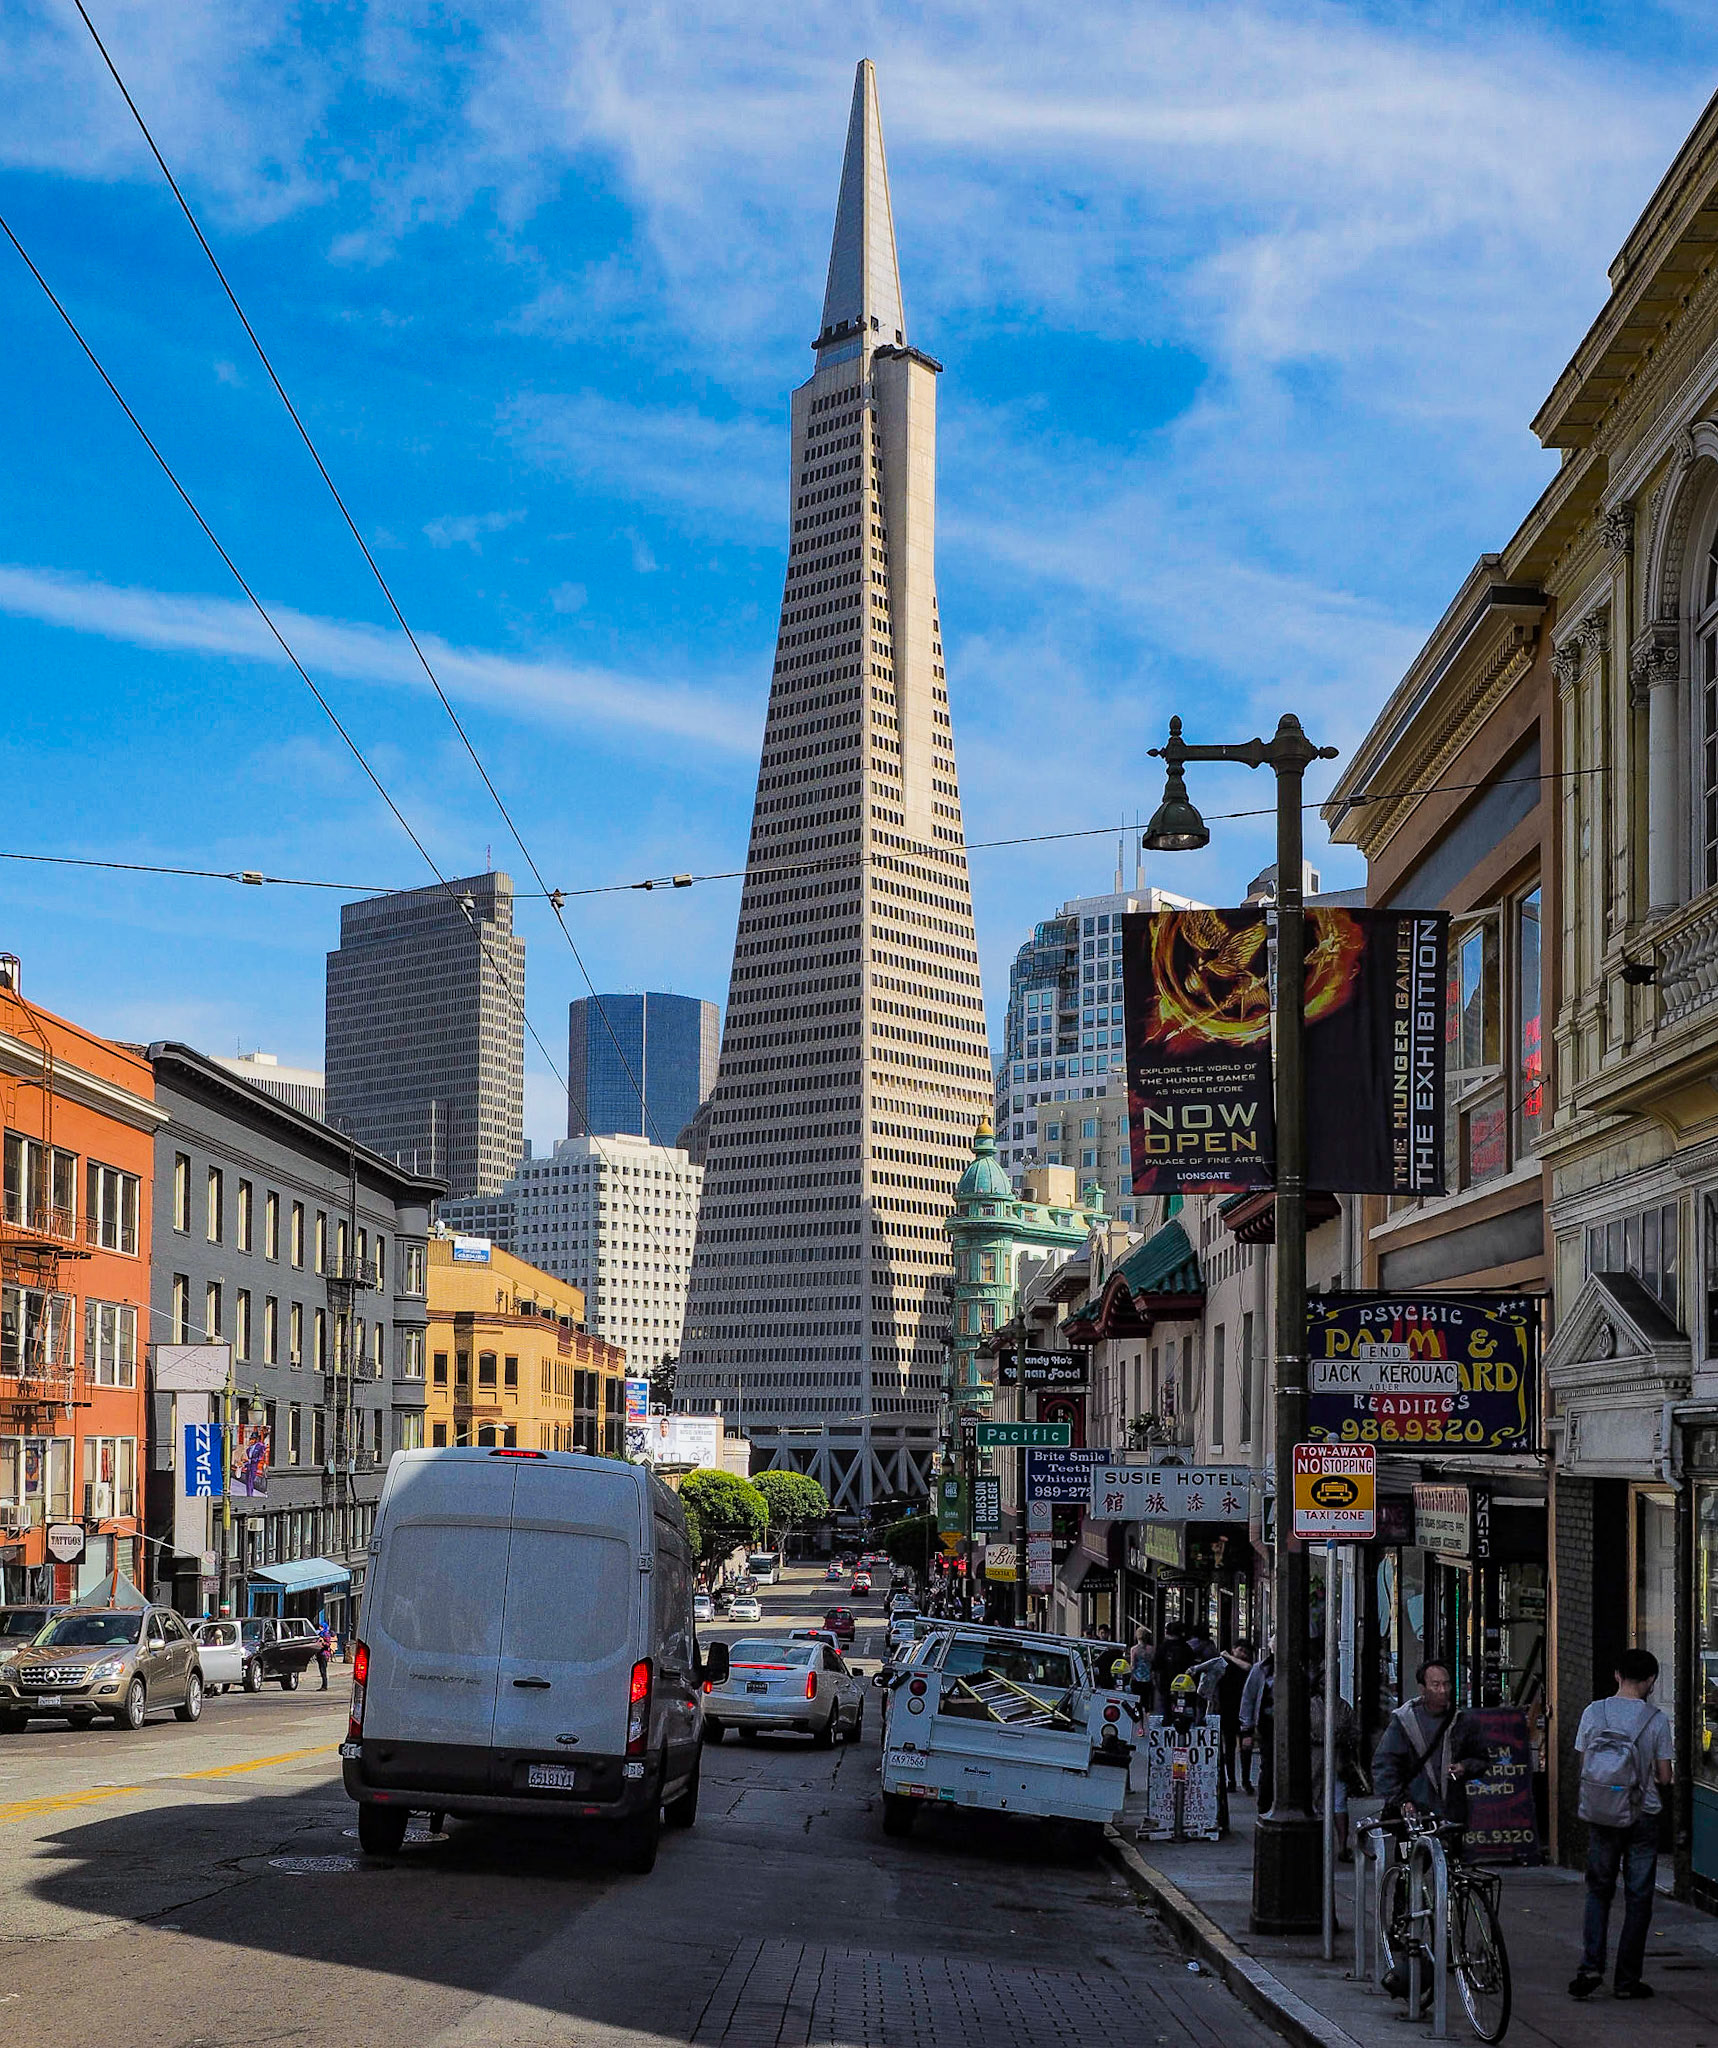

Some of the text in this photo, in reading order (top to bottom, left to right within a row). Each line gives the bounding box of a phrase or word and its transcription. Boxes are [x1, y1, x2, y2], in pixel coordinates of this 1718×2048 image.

[1393, 920, 1411, 1189] THE HUNGER GAMES
[1416, 919, 1438, 1190] THE EXHIBITION
[1140, 1066, 1182, 1075] EXPLORE
[1206, 1064, 1241, 1072] WORLD
[1140, 1073, 1256, 1085] THE HUNGER GAMES
[1172, 1087, 1203, 1095] NEVER
[1206, 1085, 1244, 1093] BEFORE
[1143, 1101, 1258, 1130] NOW
[1144, 1130, 1257, 1154] OPEN
[1144, 1155, 1262, 1166] PALACE OF FINE ARTS
[1177, 1171, 1231, 1180] LIONSGATE
[1360, 1305, 1464, 1325] PSYCHIC
[1468, 1329, 1498, 1358] &
[1369, 1346, 1401, 1357] END
[1004, 1367, 1080, 1380] Hnan Food
[1319, 1365, 1456, 1383] JACK KEROUAC
[1458, 1362, 1518, 1391] ARD
[1369, 1383, 1399, 1391] ADLER
[1353, 1394, 1470, 1414] READINGS
[987, 1428, 1059, 1441] Pacific
[1340, 1419, 1484, 1442] 986.9320
[1034, 1451, 1105, 1462] Brite Smile
[1300, 1446, 1368, 1457] TOW-AWAY
[196, 1424, 211, 1496] SFJAZZ
[1297, 1458, 1372, 1474] NO STOPPING
[1047, 1464, 1090, 1473] Teeth
[1031, 1474, 1090, 1483] Whiteni
[1104, 1472, 1243, 1486] SUSIE HOTEL
[975, 1481, 987, 1522] BABSON
[987, 1481, 998, 1522] COLLEGE
[1304, 1510, 1365, 1520] TAXI ZONE
[51, 1536, 81, 1545] TATTOOS
[1149, 1730, 1218, 1747] SMOKE
[1156, 1747, 1214, 1765] SOP
